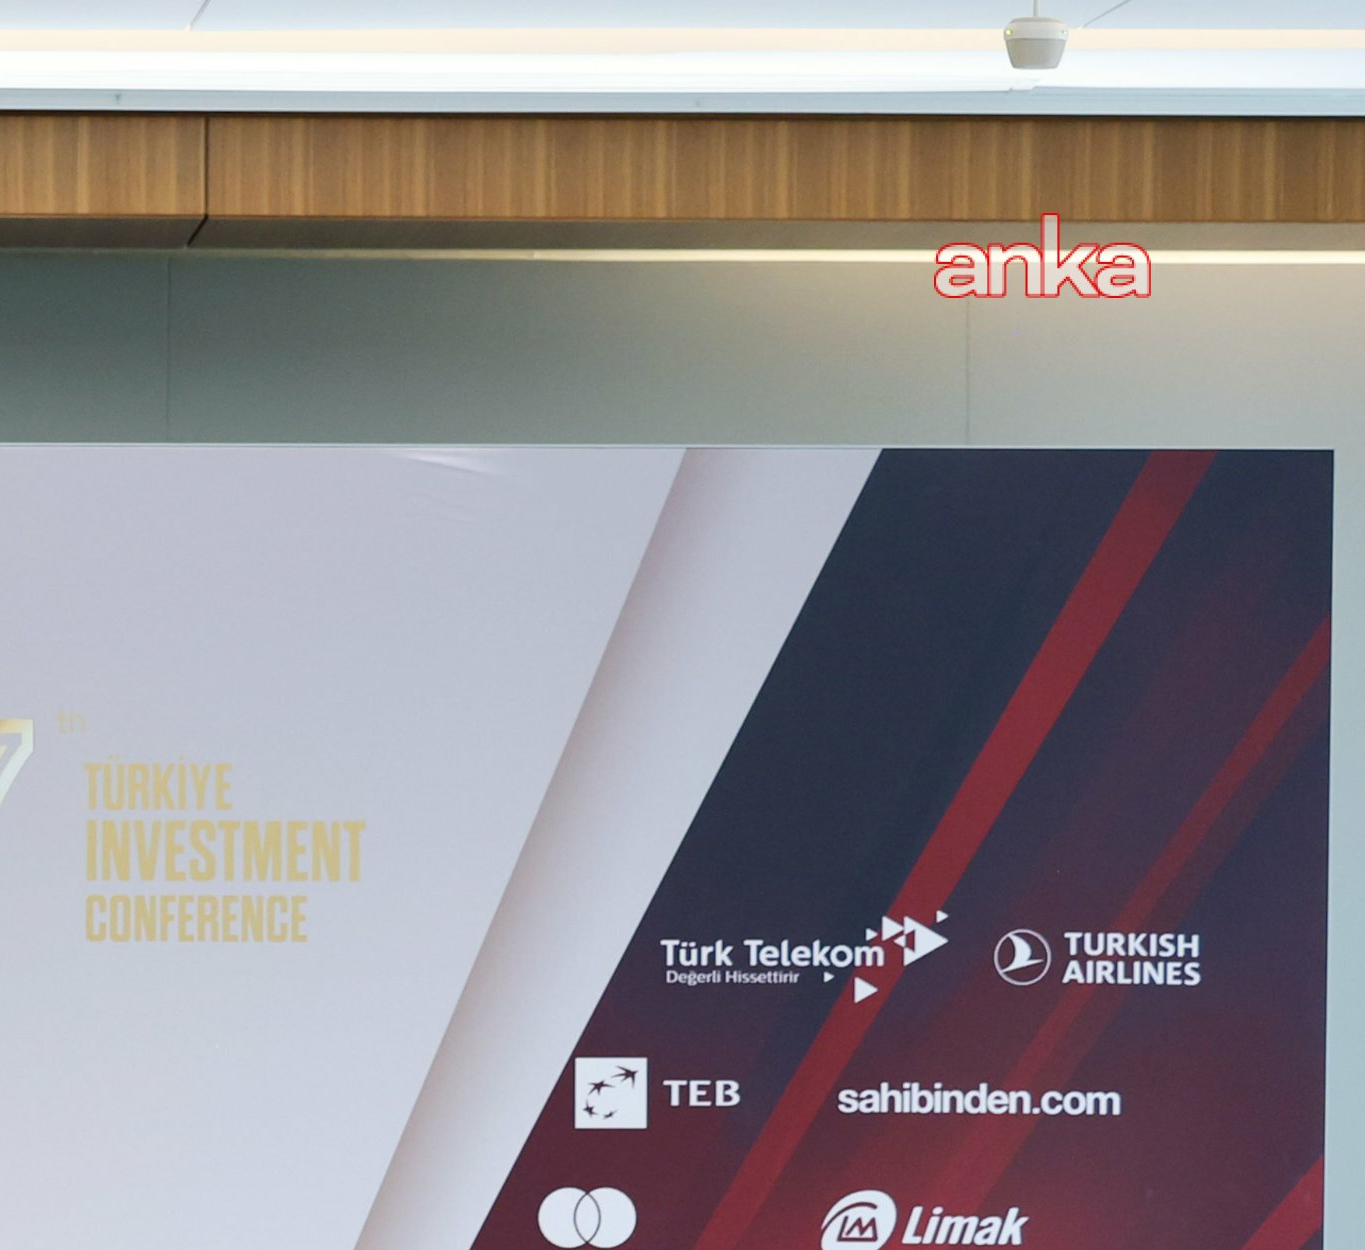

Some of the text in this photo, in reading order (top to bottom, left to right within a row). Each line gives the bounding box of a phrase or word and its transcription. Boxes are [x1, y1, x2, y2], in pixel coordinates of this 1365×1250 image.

[85, 757, 233, 811] TÜRKİYE
[86, 820, 366, 881] INVESTMENT
[86, 894, 308, 943] CONFERENCE
[661, 940, 885, 967] Türk Telekom
[1064, 932, 1199, 957] TURKISH
[665, 970, 800, 986] Değerli Hissettirir
[1062, 961, 1201, 985] AIRLINES
[663, 1080, 740, 1106] TEB
[838, 1082, 1120, 1115] sahibinden.com
[902, 1206, 1028, 1245] Limak
